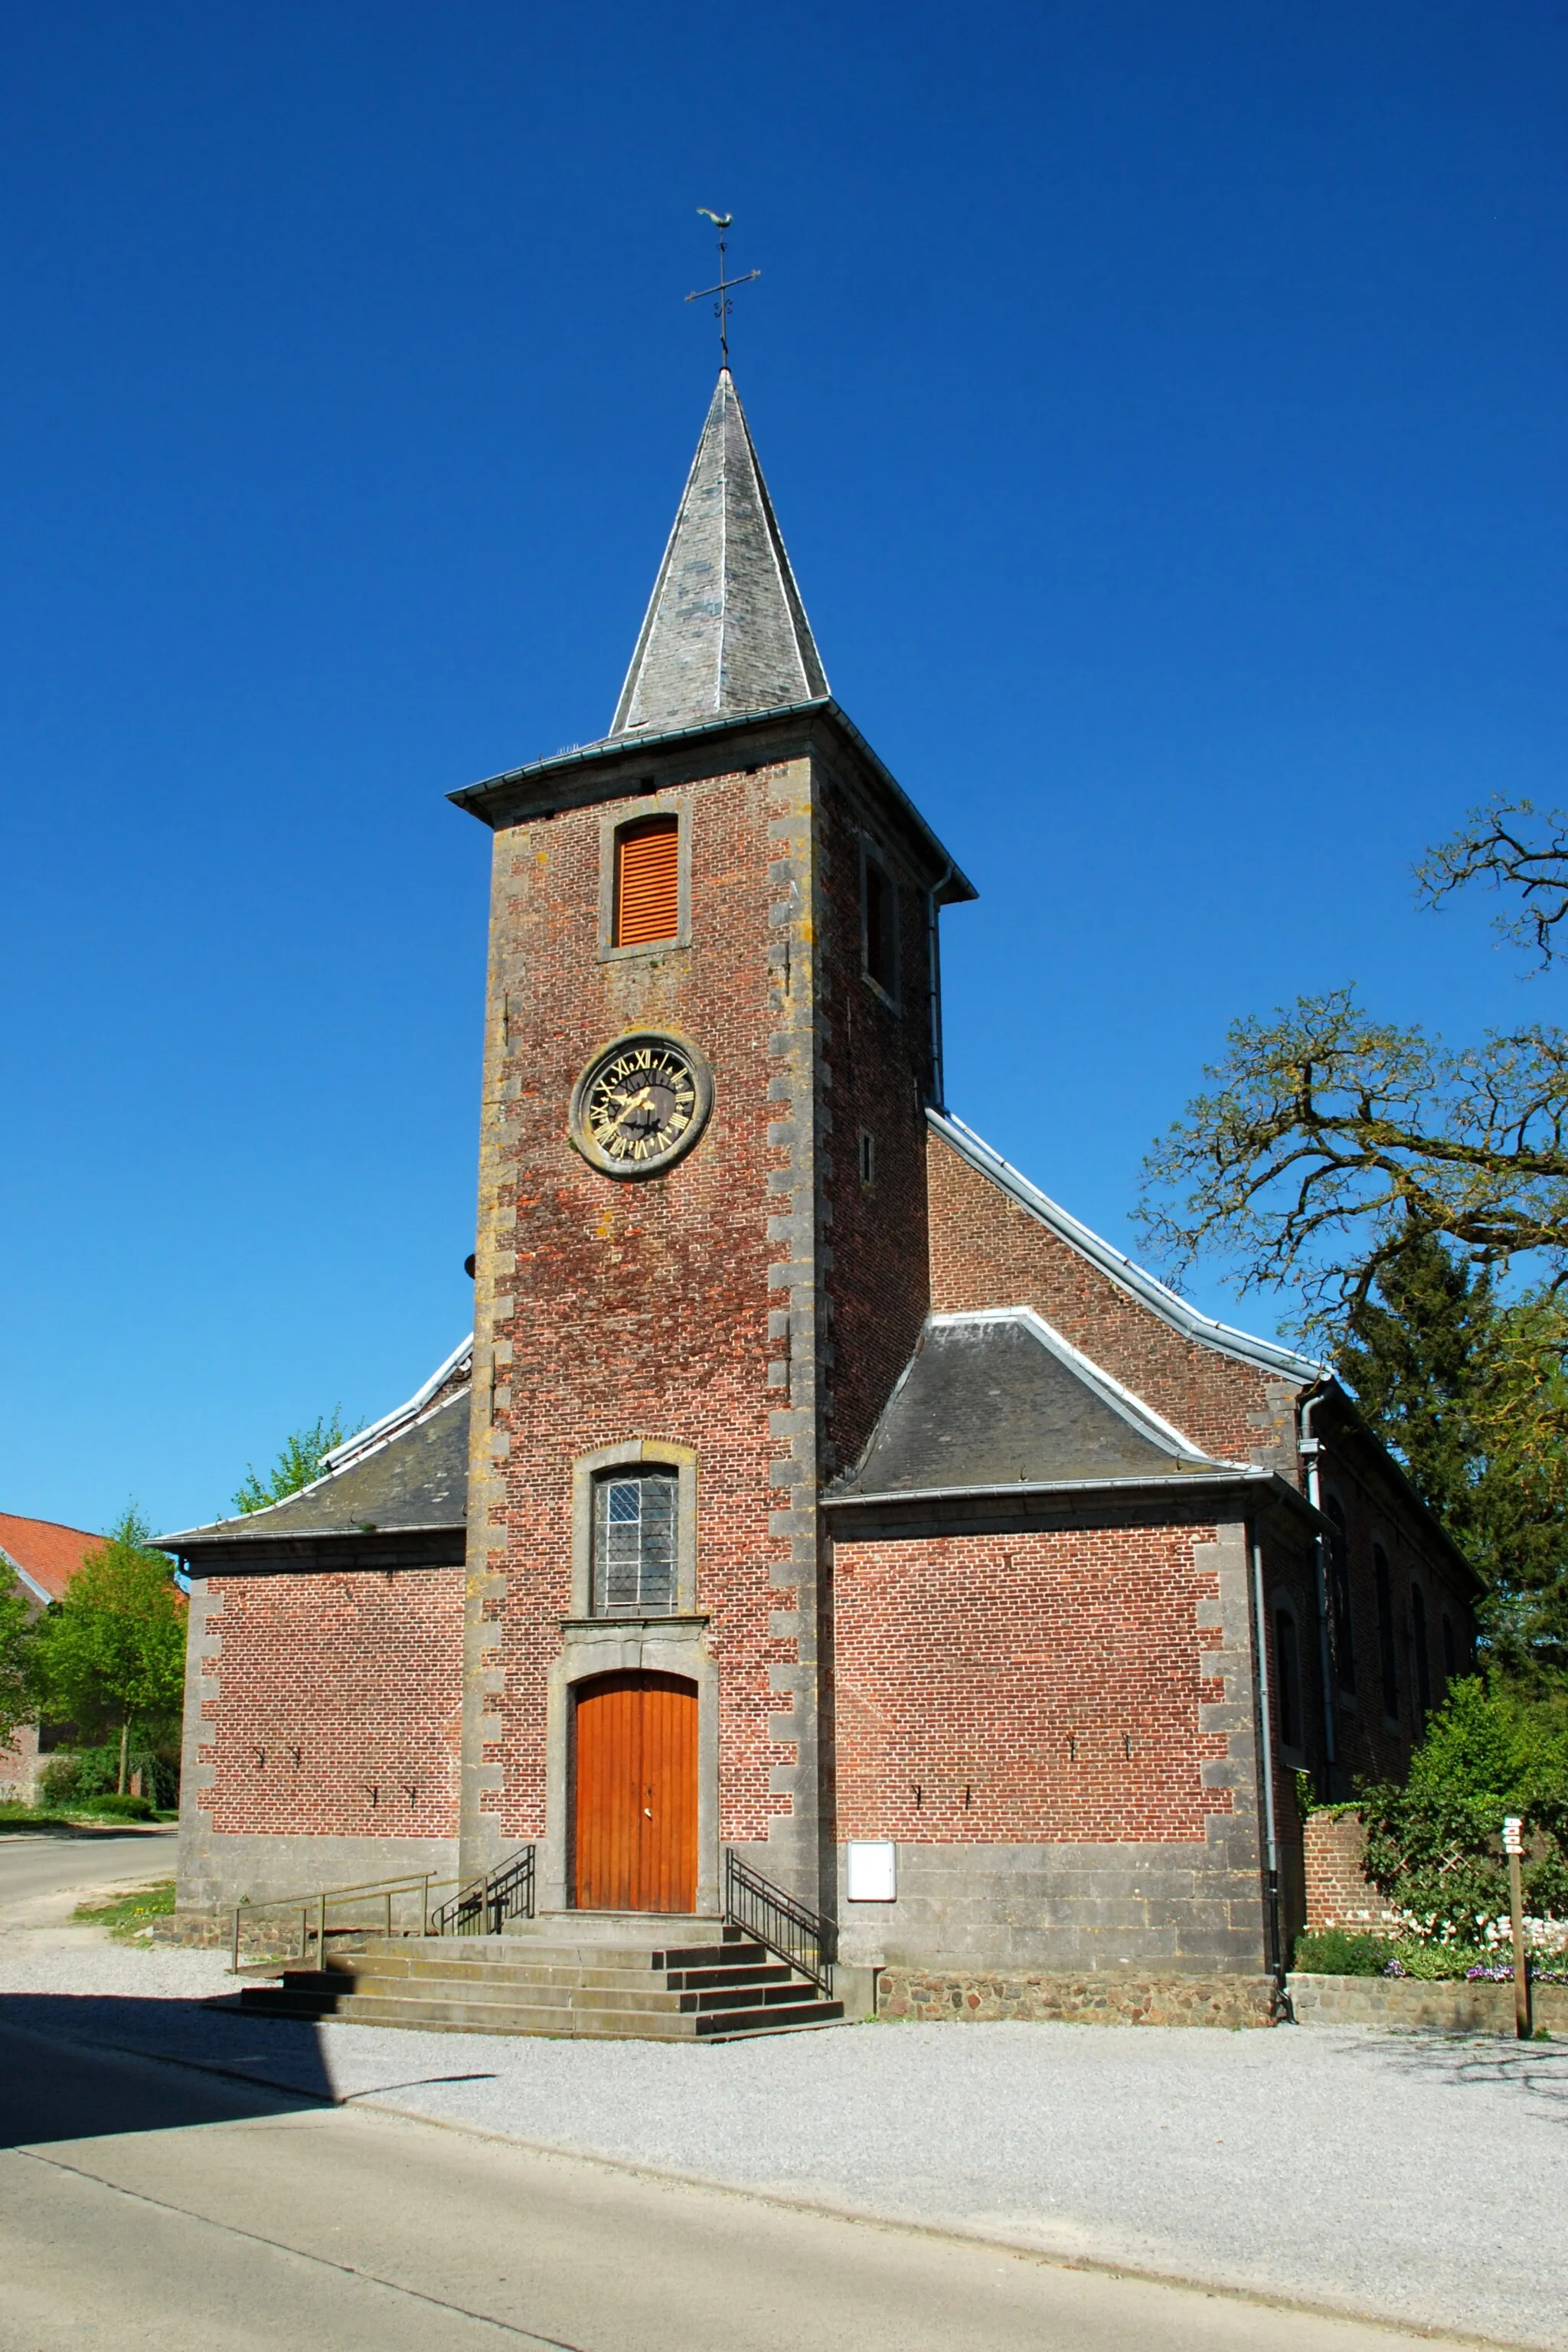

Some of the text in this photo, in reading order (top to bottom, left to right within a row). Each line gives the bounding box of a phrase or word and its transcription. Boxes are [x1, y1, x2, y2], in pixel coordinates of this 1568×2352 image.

[611, 1057, 631, 1080] XI
[635, 1050, 651, 1070] XII
[658, 1053, 669, 1070] I
[670, 1067, 688, 1083] II
[675, 1091, 694, 1102] III
[590, 1103, 608, 1119] IX
[634, 1139, 648, 1160] VI
[657, 1132, 672, 1151] V
